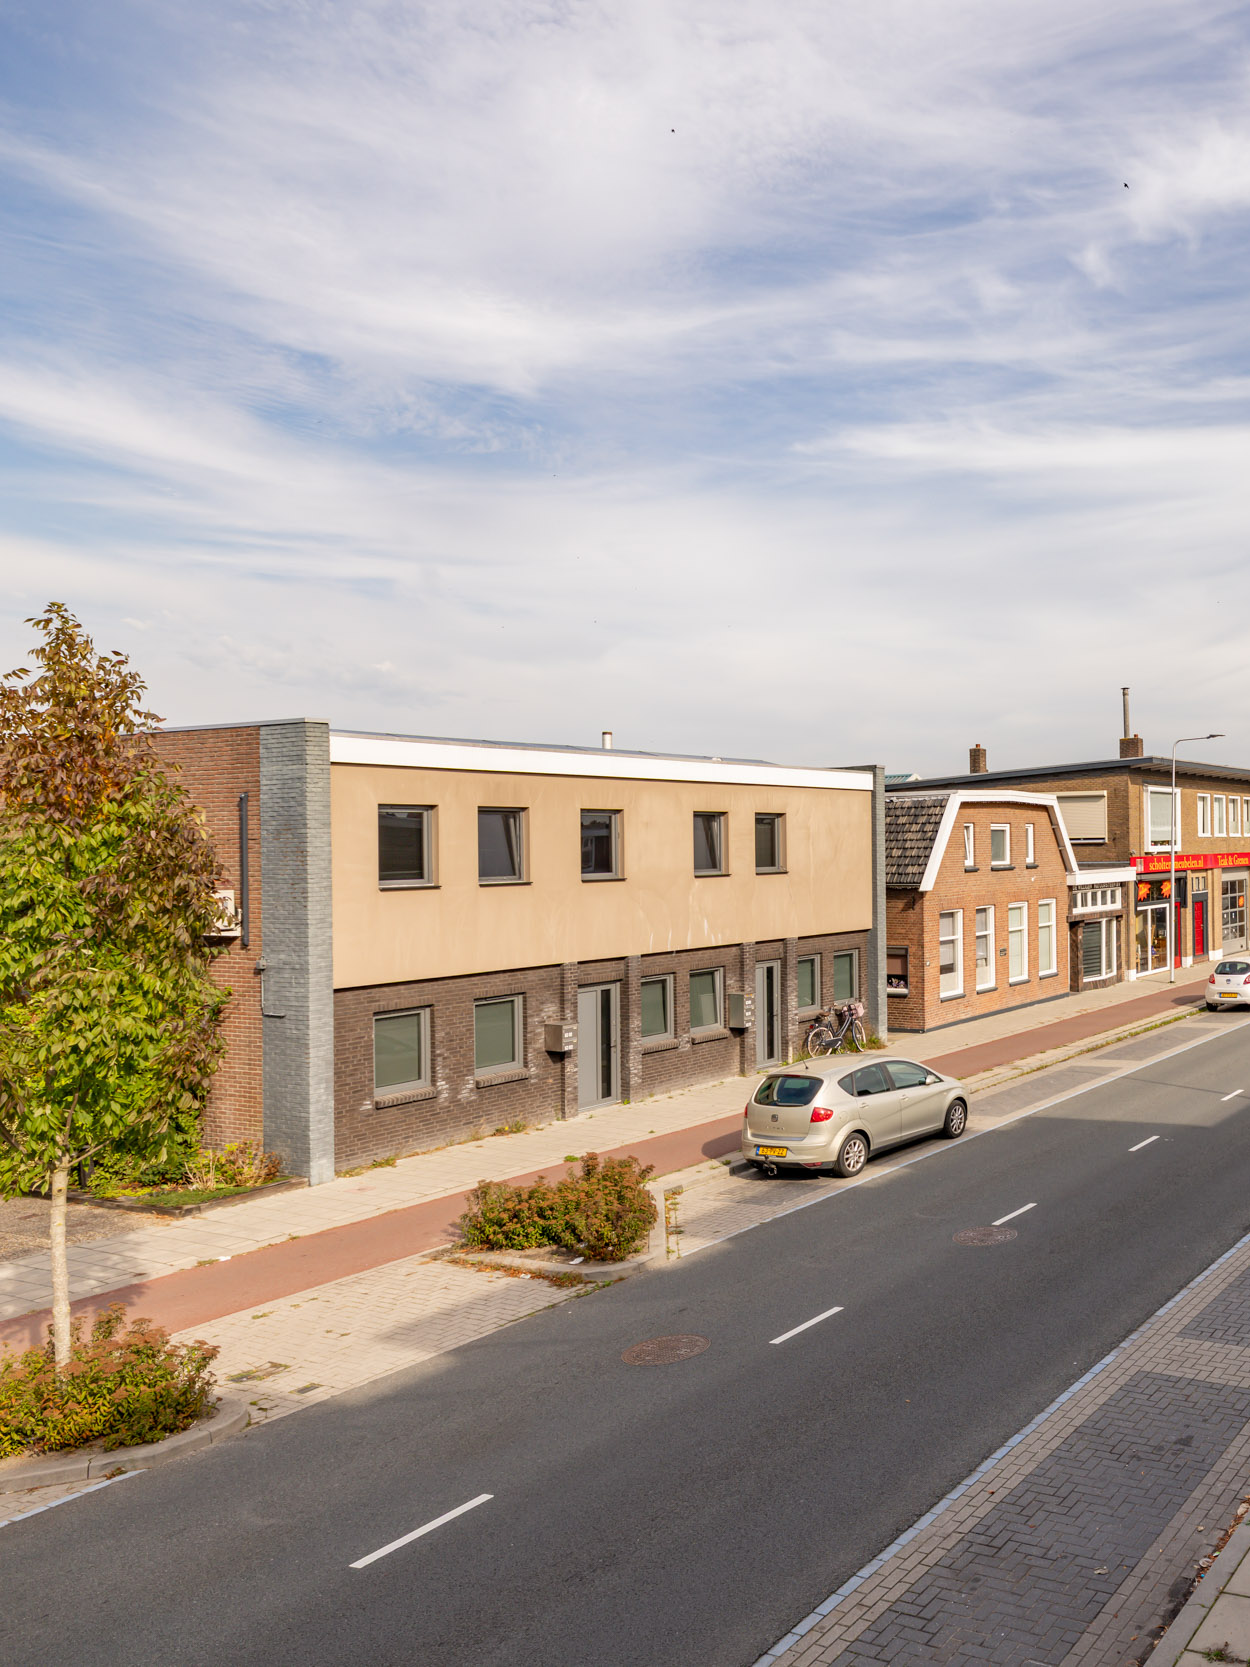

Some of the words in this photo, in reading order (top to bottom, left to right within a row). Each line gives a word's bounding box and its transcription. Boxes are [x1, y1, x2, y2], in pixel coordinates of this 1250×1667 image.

[1149, 856, 1204, 871] scholtenmeubelen.nl
[1217, 855, 1228, 866] Teak
[1233, 854, 1249, 865] Grenen
